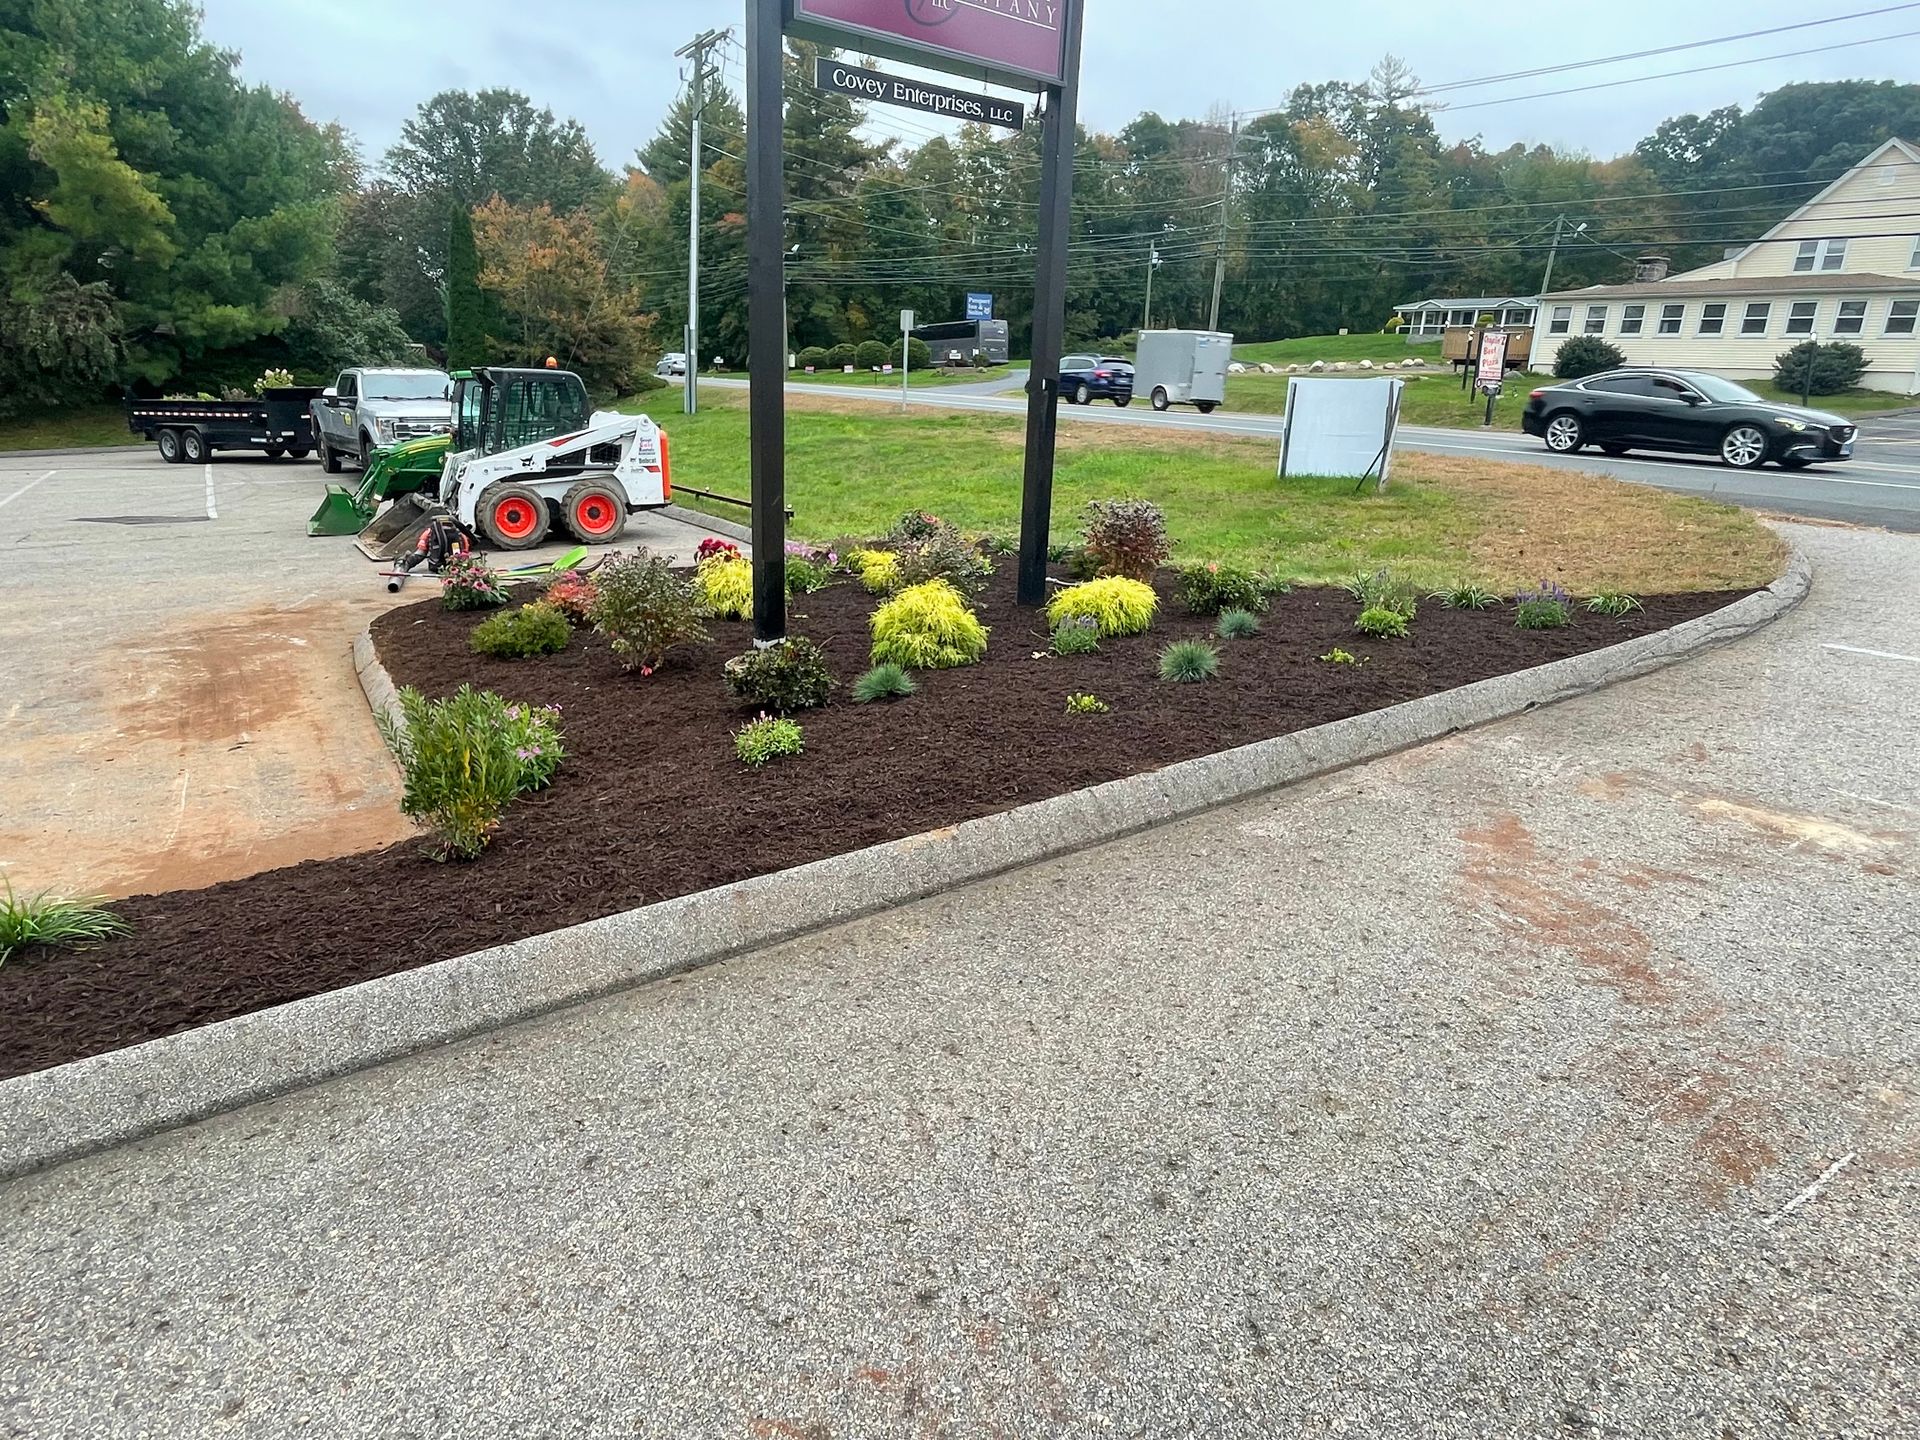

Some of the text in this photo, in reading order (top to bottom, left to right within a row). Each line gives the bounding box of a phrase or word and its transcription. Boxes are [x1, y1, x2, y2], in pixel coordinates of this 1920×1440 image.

[832, 68, 1013, 122] Covey Enterprises, LLC
[1481, 358, 1499, 367] Pizza
